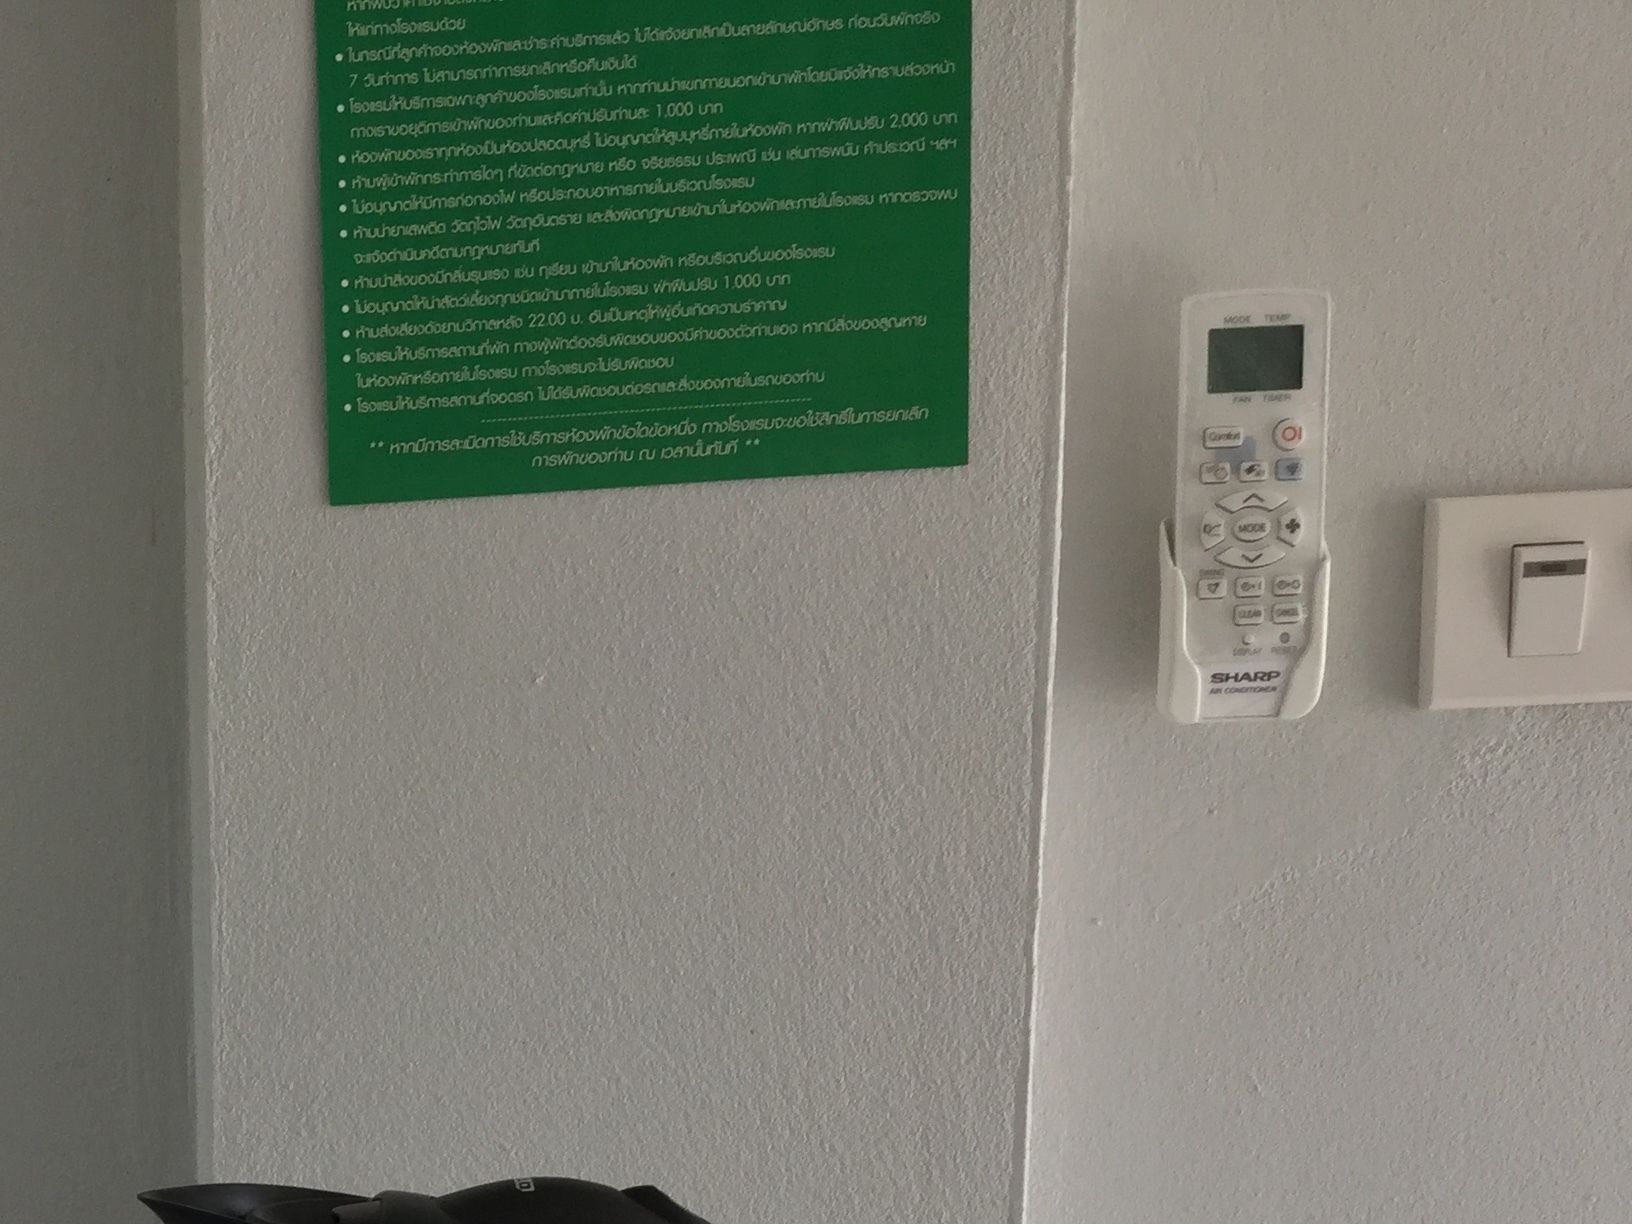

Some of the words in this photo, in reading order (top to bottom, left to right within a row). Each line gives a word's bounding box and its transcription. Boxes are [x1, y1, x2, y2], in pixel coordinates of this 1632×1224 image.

[349, 73, 359, 88] 7
[362, 71, 420, 88] วันทำการ
[698, 102, 724, 116] บาท
[932, 112, 958, 126] บาท
[608, 156, 637, 172] หรือ
[640, 154, 702, 170] จริยธรรม
[705, 148, 757, 166] ประเพณี
[760, 147, 782, 162] เช่น
[929, 138, 958, 152] ฯลฯ
[514, 264, 535, 279] เช่น
[538, 261, 578, 280] ทุเรียน
[765, 273, 791, 287] บาท
[527, 311, 567, 328] 22.00
[570, 313, 584, 325] น.
[638, 448, 656, 461] ณ
[1238, 522, 1267, 533] MODE
[1210, 670, 1282, 684] SHARP
[1209, 687, 1223, 695] AIR
[1225, 686, 1278, 695] CONDITIONER
